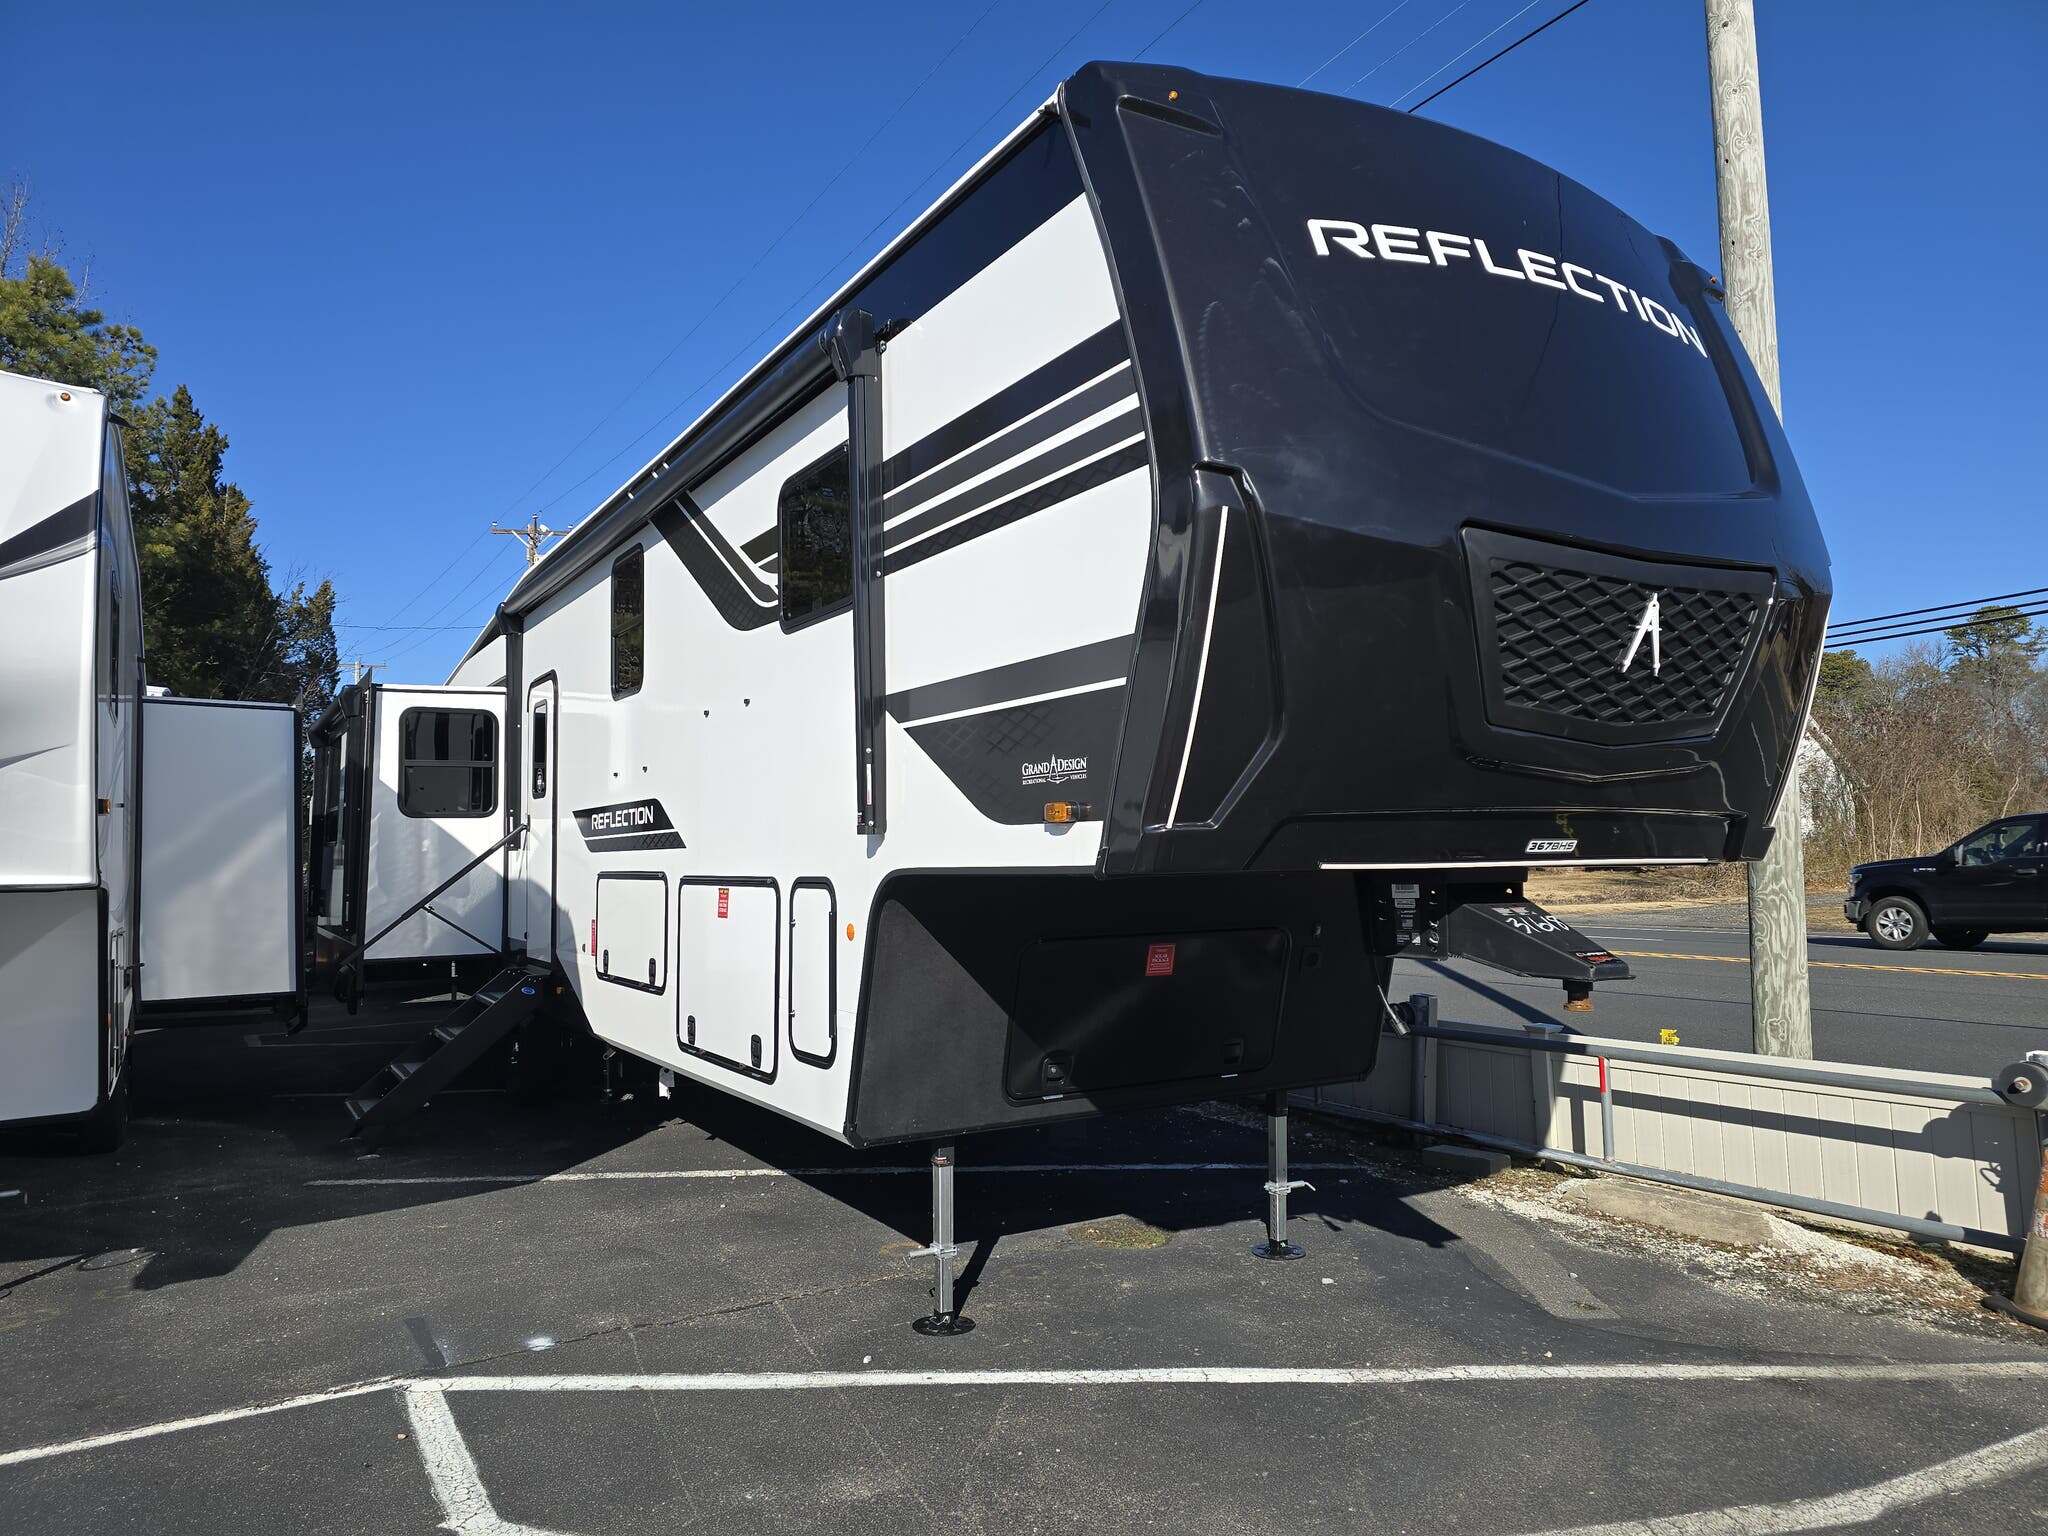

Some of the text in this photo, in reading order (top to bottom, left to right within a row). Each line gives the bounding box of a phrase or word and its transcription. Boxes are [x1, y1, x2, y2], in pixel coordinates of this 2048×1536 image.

[1307, 218, 1708, 359] REFLECTION
[1022, 757, 1087, 775] GRAND DESIGN
[591, 805, 654, 830] REFLECTION
[1528, 841, 1576, 851] 367BHS
